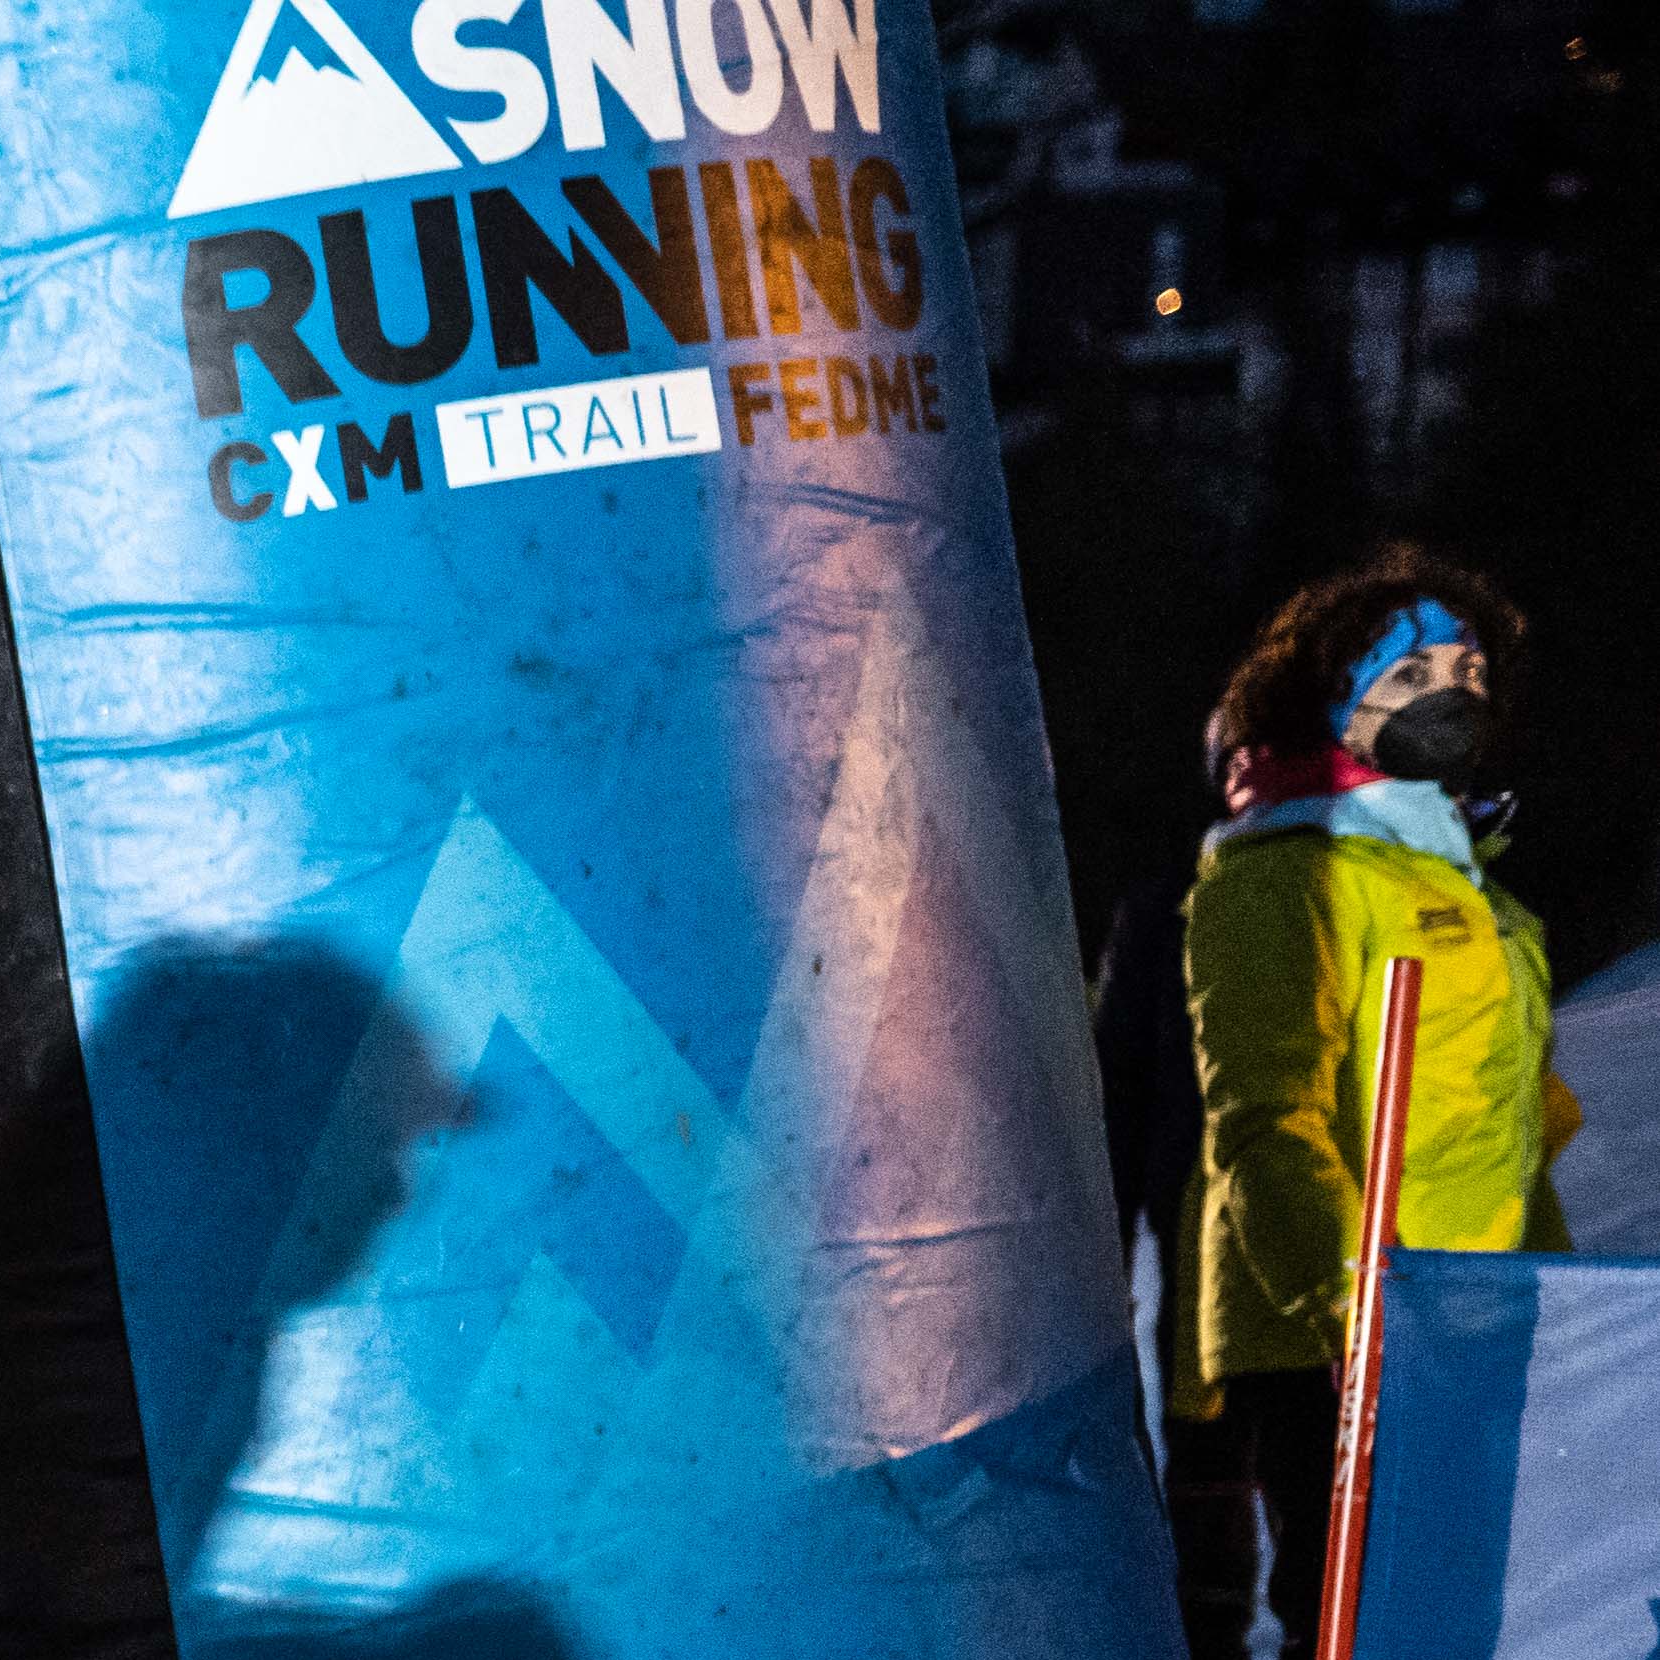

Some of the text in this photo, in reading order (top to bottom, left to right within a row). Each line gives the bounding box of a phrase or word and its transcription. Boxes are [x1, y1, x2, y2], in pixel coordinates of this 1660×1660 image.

[411, 0, 883, 165] SNOW
[180, 156, 924, 422] RUNNING
[208, 352, 947, 523] CXM TRAIL FEDME
